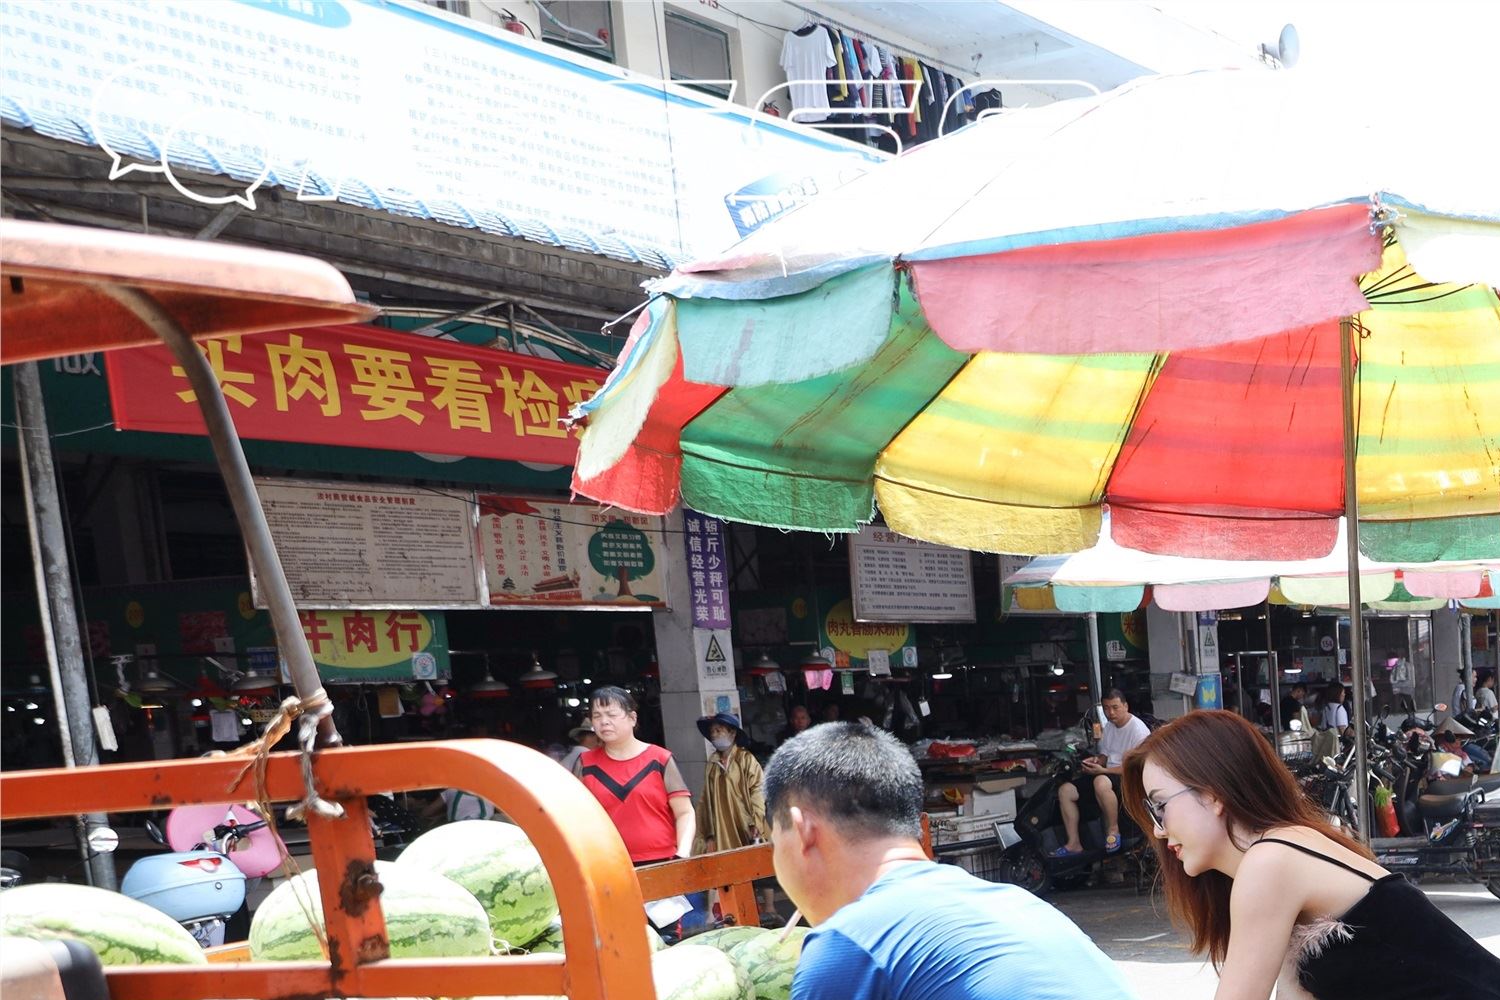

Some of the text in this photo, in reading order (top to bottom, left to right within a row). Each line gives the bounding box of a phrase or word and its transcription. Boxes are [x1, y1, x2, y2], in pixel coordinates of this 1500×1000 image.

[687, 519, 710, 622] 诚信经营光荣
[704, 520, 727, 622] 短斤少秤可耻
[296, 610, 423, 654] 牛肉行
